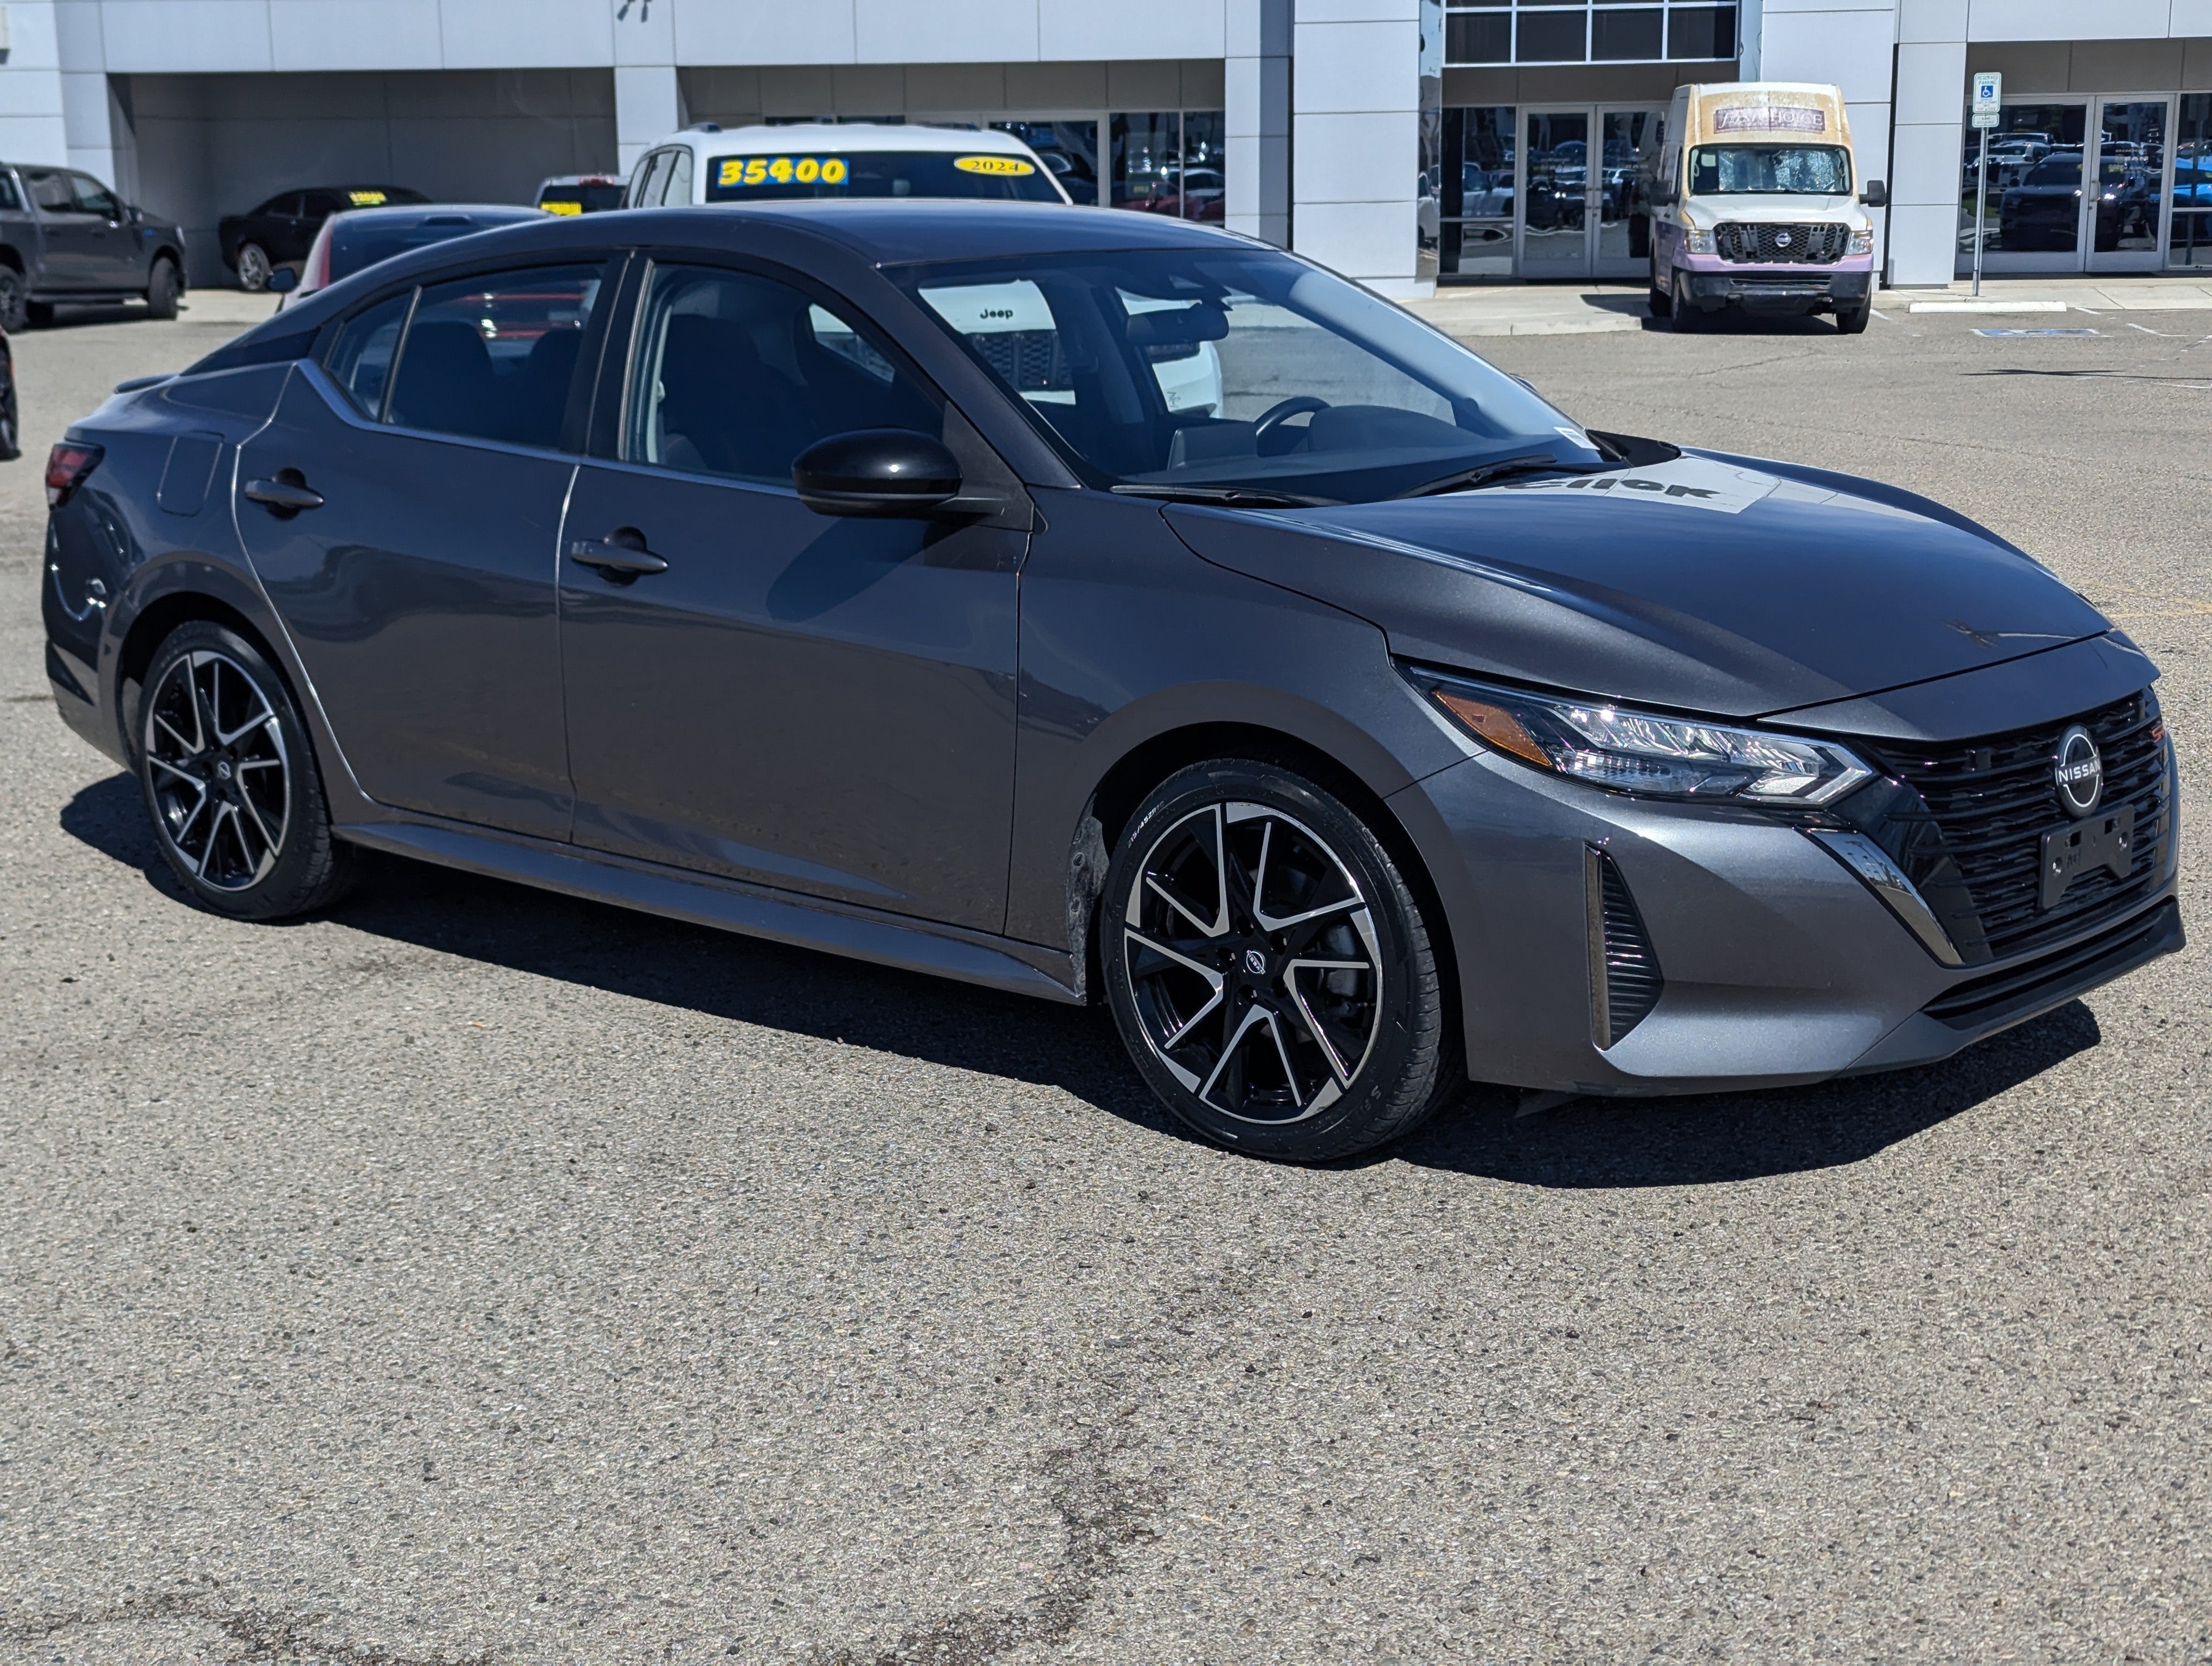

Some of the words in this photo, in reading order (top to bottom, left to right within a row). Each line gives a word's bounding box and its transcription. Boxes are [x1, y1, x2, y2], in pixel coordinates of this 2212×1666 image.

[718, 157, 846, 185] 35400
[971, 161, 1019, 171] 2024
[979, 308, 1014, 320] Jeep
[2058, 759, 2101, 783] NISSAN
